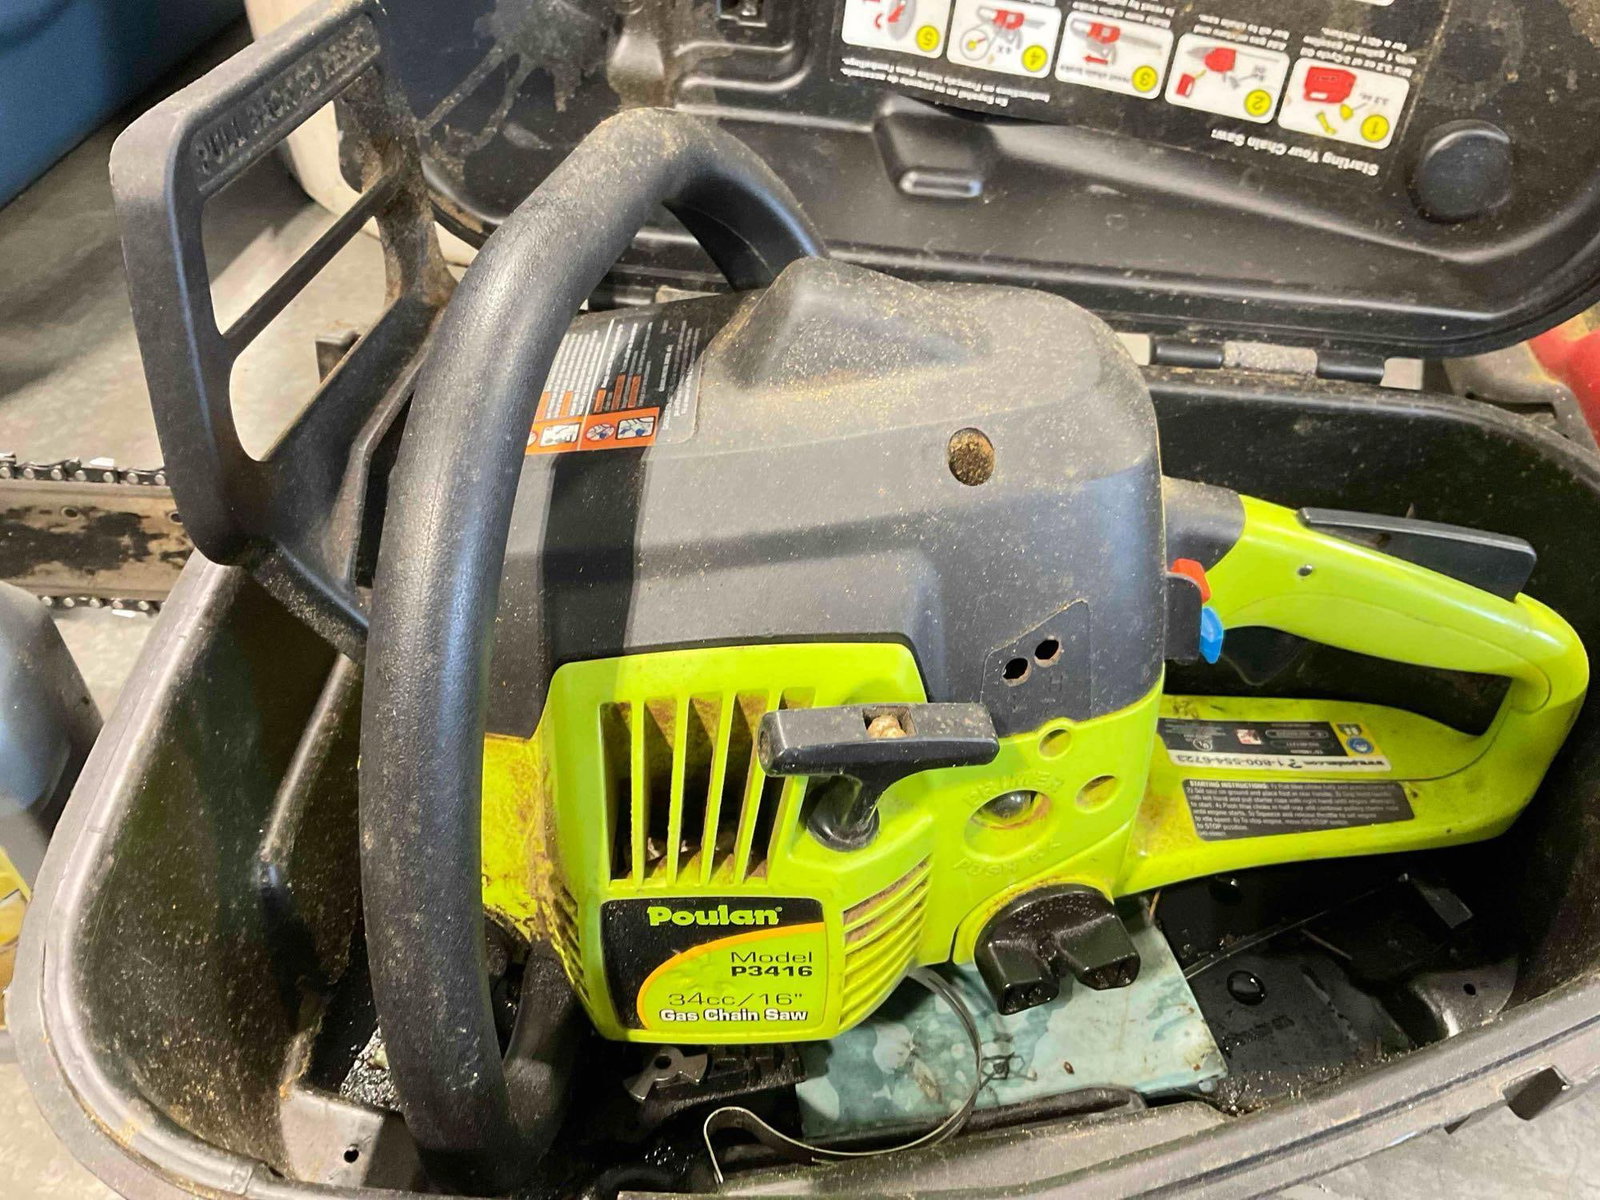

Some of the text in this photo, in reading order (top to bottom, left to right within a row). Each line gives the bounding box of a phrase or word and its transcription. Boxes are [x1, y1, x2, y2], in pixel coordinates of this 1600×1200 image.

[1029, 50, 1041, 65] 4
[1139, 71, 1150, 86] 3
[1252, 93, 1265, 109] 2
[195, 113, 247, 175] PULL
[1211, 129, 1379, 176] Starting Your Chain Saw:
[1177, 753, 1283, 768] 1-800-554-6723
[647, 905, 780, 927] Poulan
[731, 951, 812, 963] Model
[731, 966, 813, 977] P3416
[668, 993, 803, 1006] 34cc/16"
[659, 1009, 808, 1021] Gas Chain Saw
